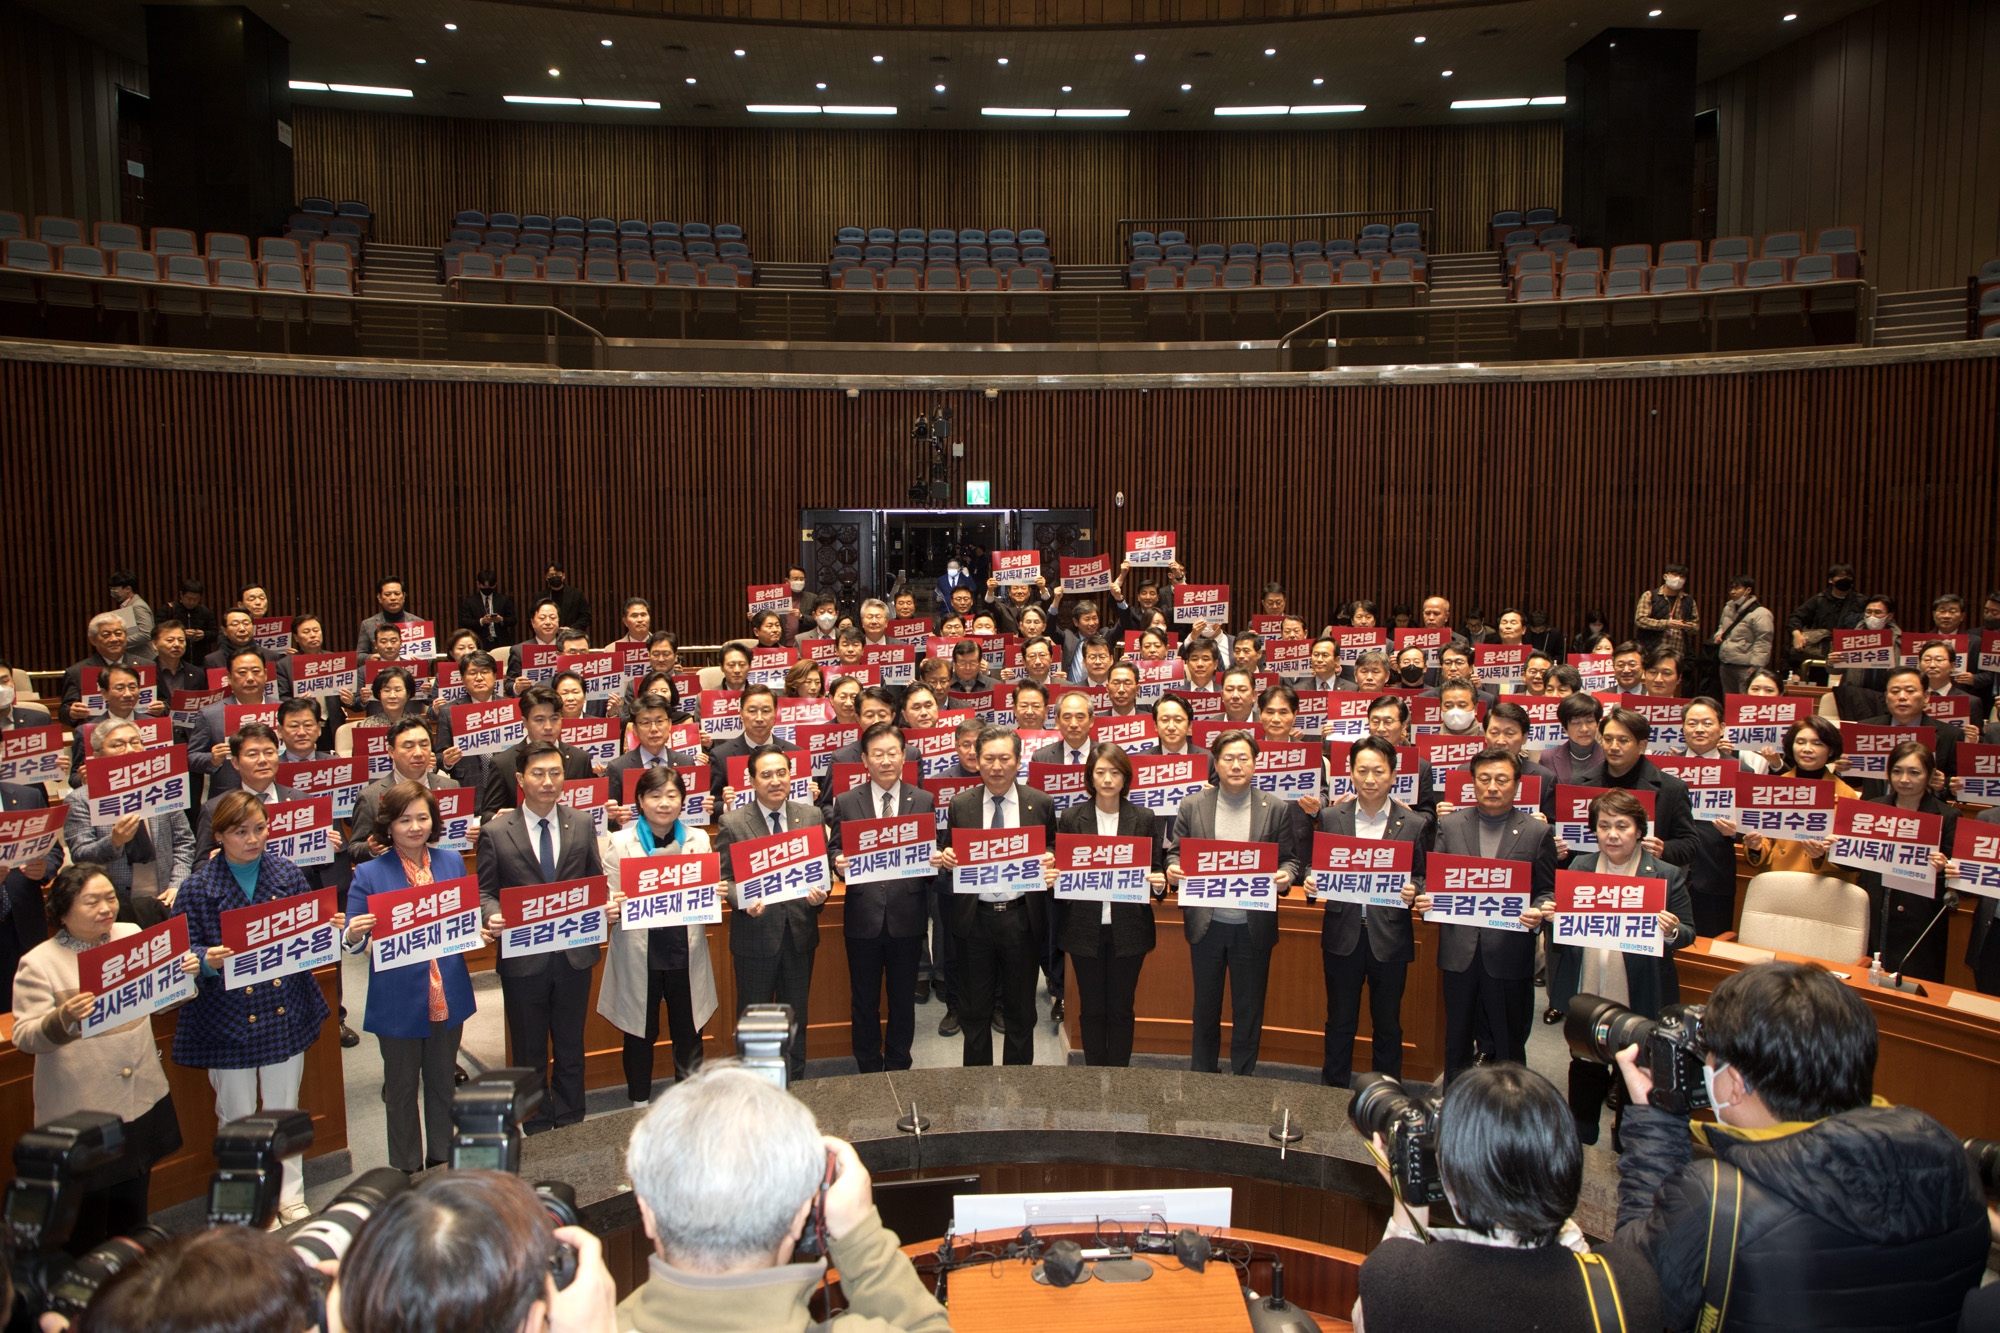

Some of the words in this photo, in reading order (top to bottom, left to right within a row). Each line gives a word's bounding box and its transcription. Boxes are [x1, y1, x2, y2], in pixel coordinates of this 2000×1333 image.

[1135, 535, 1167, 549] 김건희
[1001, 554, 1031, 568] 윤석열
[1129, 548, 1172, 562] 특검수용
[995, 569, 1022, 582] 검사독재
[1024, 567, 1037, 578] 규탄
[1069, 560, 1102, 576] 김건희
[1064, 572, 1109, 590] 특검수용
[755, 587, 783, 601] 윤석열
[1183, 589, 1219, 604] 윤석열
[751, 600, 775, 613] 검사독재
[777, 598, 789, 610] 규탄
[1177, 605, 1206, 619] 검사독재
[1209, 603, 1225, 617] 규탄
[253, 621, 282, 635] 건희
[401, 625, 425, 639] 건희
[894, 622, 925, 636] 김건희
[399, 640, 432, 655] 검수용
[983, 638, 1004, 651] 석열
[1341, 632, 1377, 646] 김건희
[1403, 632, 1440, 648] 윤석열
[1842, 634, 1881, 650] 김건희
[752, 651, 788, 667] 김건희
[812, 644, 836, 658] 김건
[867, 649, 905, 664] 윤석열
[1274, 643, 1310, 659] 윤석열
[1483, 649, 1521, 665] 윤석열
[305, 657, 346, 677] 윤석열
[896, 663, 912, 678] 규탄
[1269, 660, 1299, 673] 검사독재
[1476, 666, 1510, 679] 검사독재
[297, 677, 333, 693] 검사독재
[337, 672, 353, 687] 규탄
[602, 675, 620, 691] 규탄
[713, 698, 742, 715] 윤석
[781, 703, 825, 722] 김건희
[1189, 698, 1220, 712] 건희
[1299, 698, 1327, 712] 김건
[1341, 698, 1369, 716] 김건
[1738, 703, 1796, 722] 윤석열
[1924, 701, 1954, 715] 건희
[466, 705, 514, 729] 윤석열
[704, 718, 743, 733] 검사독재
[458, 729, 501, 751] 검사독재
[504, 721, 525, 740] 규탄
[561, 723, 608, 741] 김건희
[809, 732, 858, 751] 윤석열
[1097, 720, 1145, 743] 김건희
[1729, 726, 1776, 744] 검사독재
[0, 733, 47, 758] 건희
[588, 743, 616, 758] 수용
[0, 754, 58, 780] 검수용
[1255, 749, 1306, 769] 김건희
[108, 753, 170, 791] 김건희
[293, 763, 352, 791] 윤석열
[1044, 772, 1085, 791] 김건
[1138, 760, 1193, 785] 김건희
[98, 777, 183, 817] 특검수용
[558, 785, 593, 808] 석열
[1705, 790, 1733, 808] 규탄
[1752, 785, 1816, 805] 김건희
[0, 815, 48, 838] 석열
[268, 806, 314, 832] 석열
[1741, 810, 1828, 832] 특검수용
[1851, 813, 1921, 839] 윤석열
[23, 832, 55, 851] 규탄
[266, 835, 295, 857] 독재
[299, 829, 326, 855] 규탄
[859, 821, 918, 851] 윤석열
[749, 835, 809, 874] 김건희
[969, 833, 1029, 860] 김건희
[1071, 844, 1134, 867] 윤석열
[1835, 839, 1893, 862] 검사독재
[1898, 844, 1930, 866] 규탄
[849, 854, 901, 878] 검사독재
[905, 845, 931, 865] 규탄
[1197, 849, 1260, 873] 김건희
[1329, 847, 1395, 868] 윤석열
[638, 860, 702, 893] 윤석열
[744, 860, 824, 901] 특검수용
[960, 858, 1040, 886] 특검수용
[1059, 871, 1112, 893] 검사독재
[1118, 869, 1145, 889] 규탄
[1445, 868, 1512, 889] 김건희
[1185, 876, 1271, 898] 특검수용
[1316, 873, 1371, 893] 검사독재
[1376, 874, 1405, 893] 규탄
[522, 885, 589, 921] 김건희
[627, 892, 682, 922] 검사독재
[687, 886, 715, 910] 규탄
[1432, 894, 1523, 918] 특검수용
[1573, 885, 1645, 909] 윤석열
[391, 886, 461, 930] 윤석열
[246, 899, 319, 946] 김건희
[509, 910, 601, 948] 특검수용
[1559, 915, 1620, 937] 검사독재
[1625, 915, 1658, 937] 규탄
[379, 926, 441, 963] 검사독재
[446, 911, 476, 940] 규탄
[101, 930, 171, 988] 윤석열
[234, 926, 333, 977] 특검수용
[88, 971, 152, 1028] 검사독재
[157, 955, 186, 992] 규탄
[154, 988, 186, 1008] 더불어민주당
